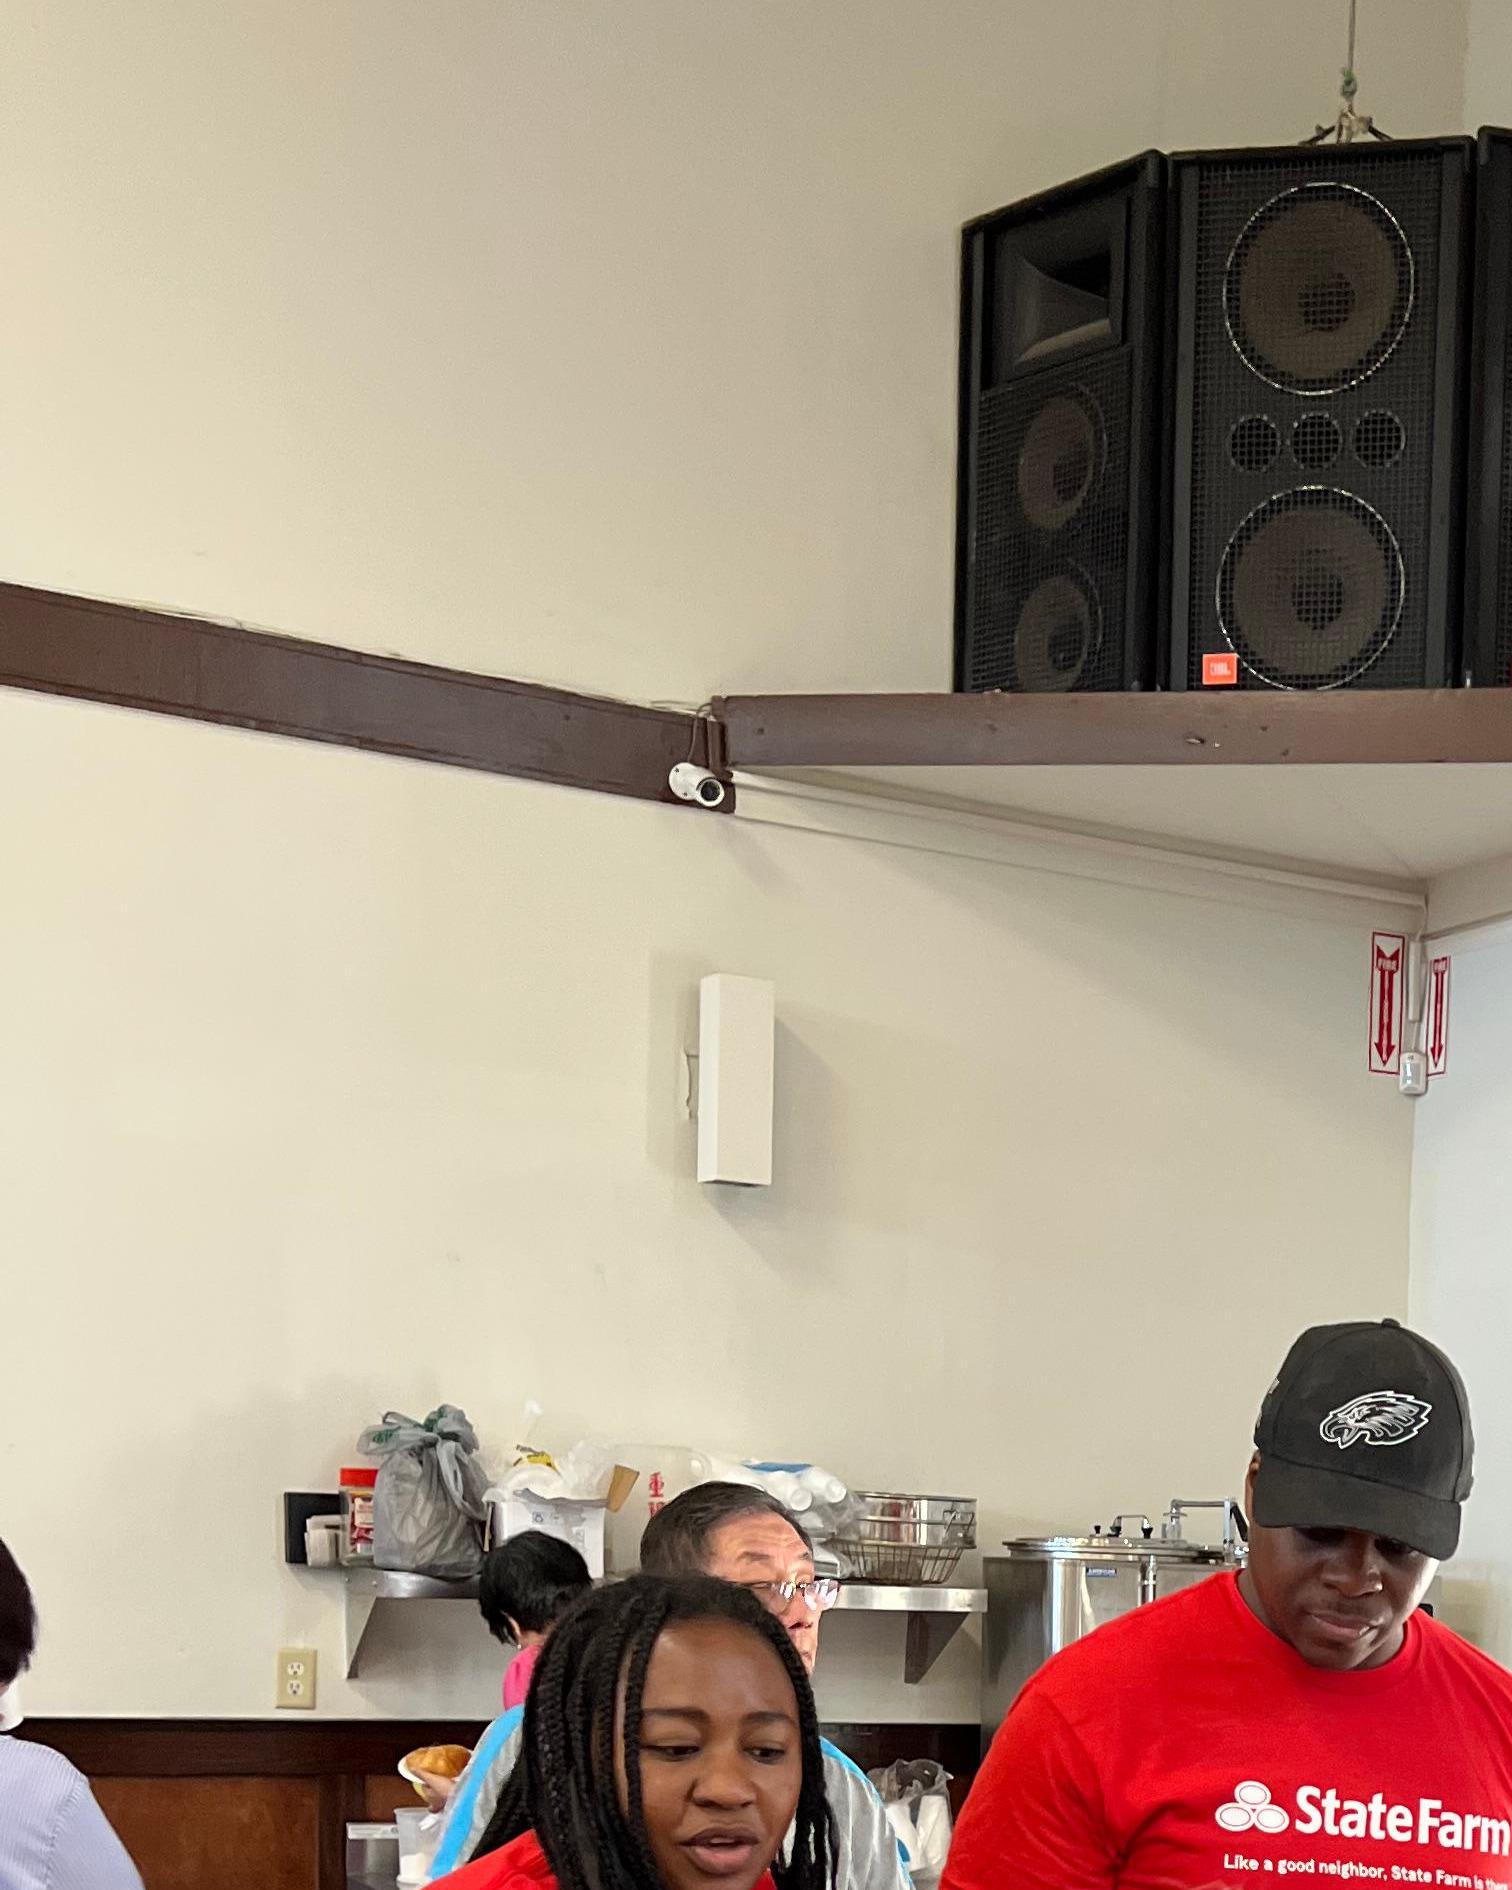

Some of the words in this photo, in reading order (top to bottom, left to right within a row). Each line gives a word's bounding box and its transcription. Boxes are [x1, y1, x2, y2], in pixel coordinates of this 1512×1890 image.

[1223, 1853, 1259, 1870] Like
[1263, 1859, 1273, 1872] a
[1277, 1859, 1315, 1875] good
[1318, 1860, 1388, 1881] neighbor,
[1390, 1865, 1432, 1883] State
[1435, 1869, 1472, 1888] Farm
[1474, 1875, 1484, 1890] is
